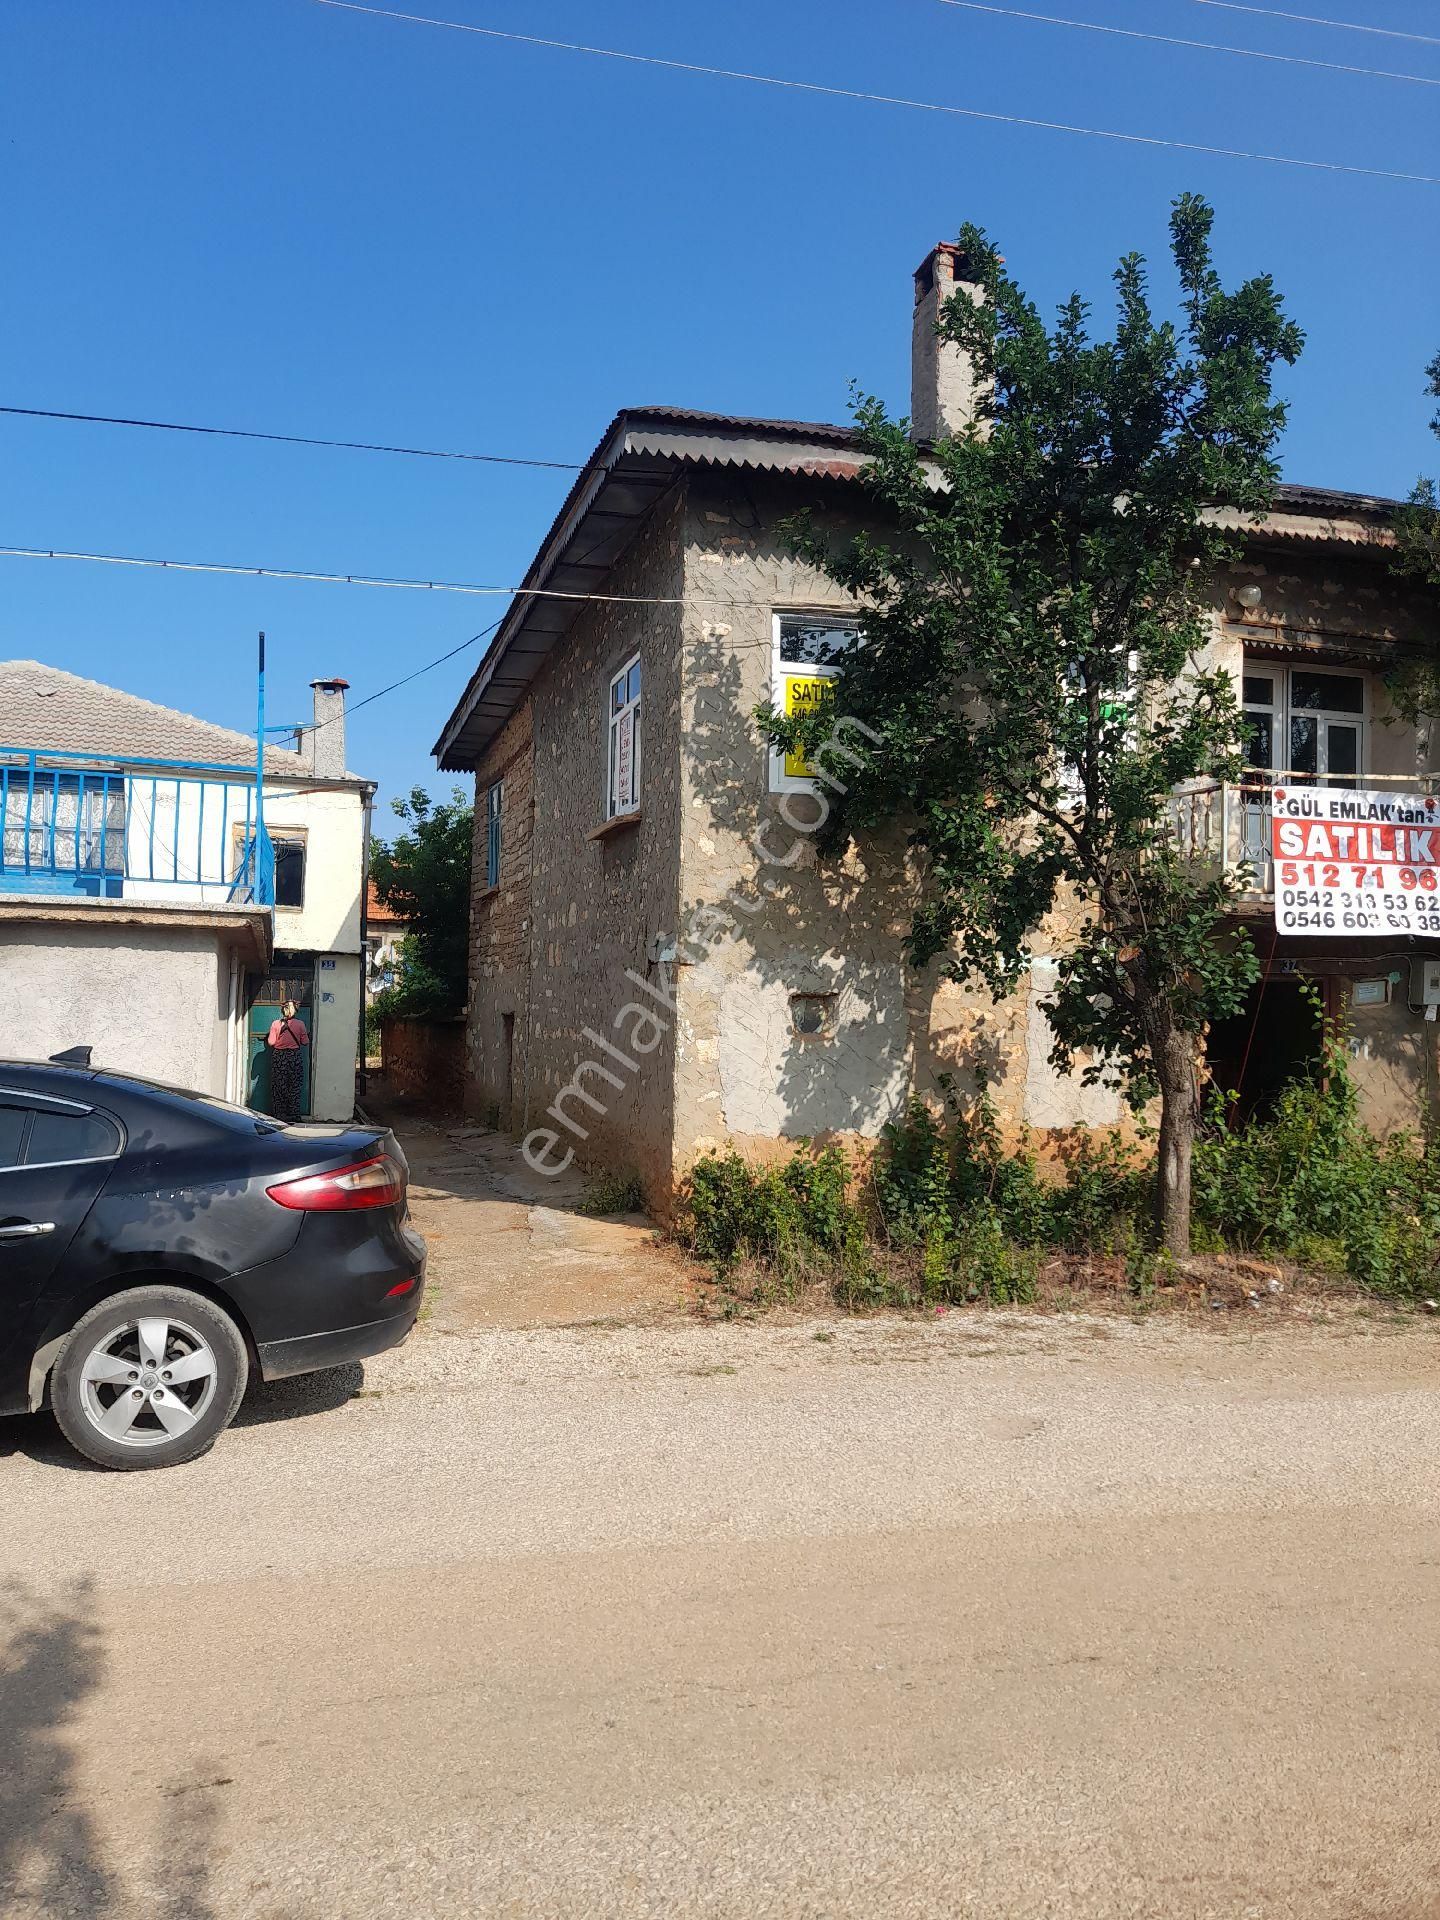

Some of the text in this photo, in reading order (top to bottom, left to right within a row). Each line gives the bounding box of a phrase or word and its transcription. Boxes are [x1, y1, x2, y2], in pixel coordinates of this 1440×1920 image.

[1287, 794, 1425, 824] GÜL EMLAK'tan
[1279, 822, 1436, 863] SATILIK
[1281, 863, 1438, 891] 512 71 96
[1283, 890, 1334, 908] 0542
[1384, 894, 1408, 911] 53
[1415, 896, 1440, 911] 62
[1283, 911, 1335, 928] 0546
[1386, 914, 1411, 929] 60
[1417, 915, 1440, 931] 38
